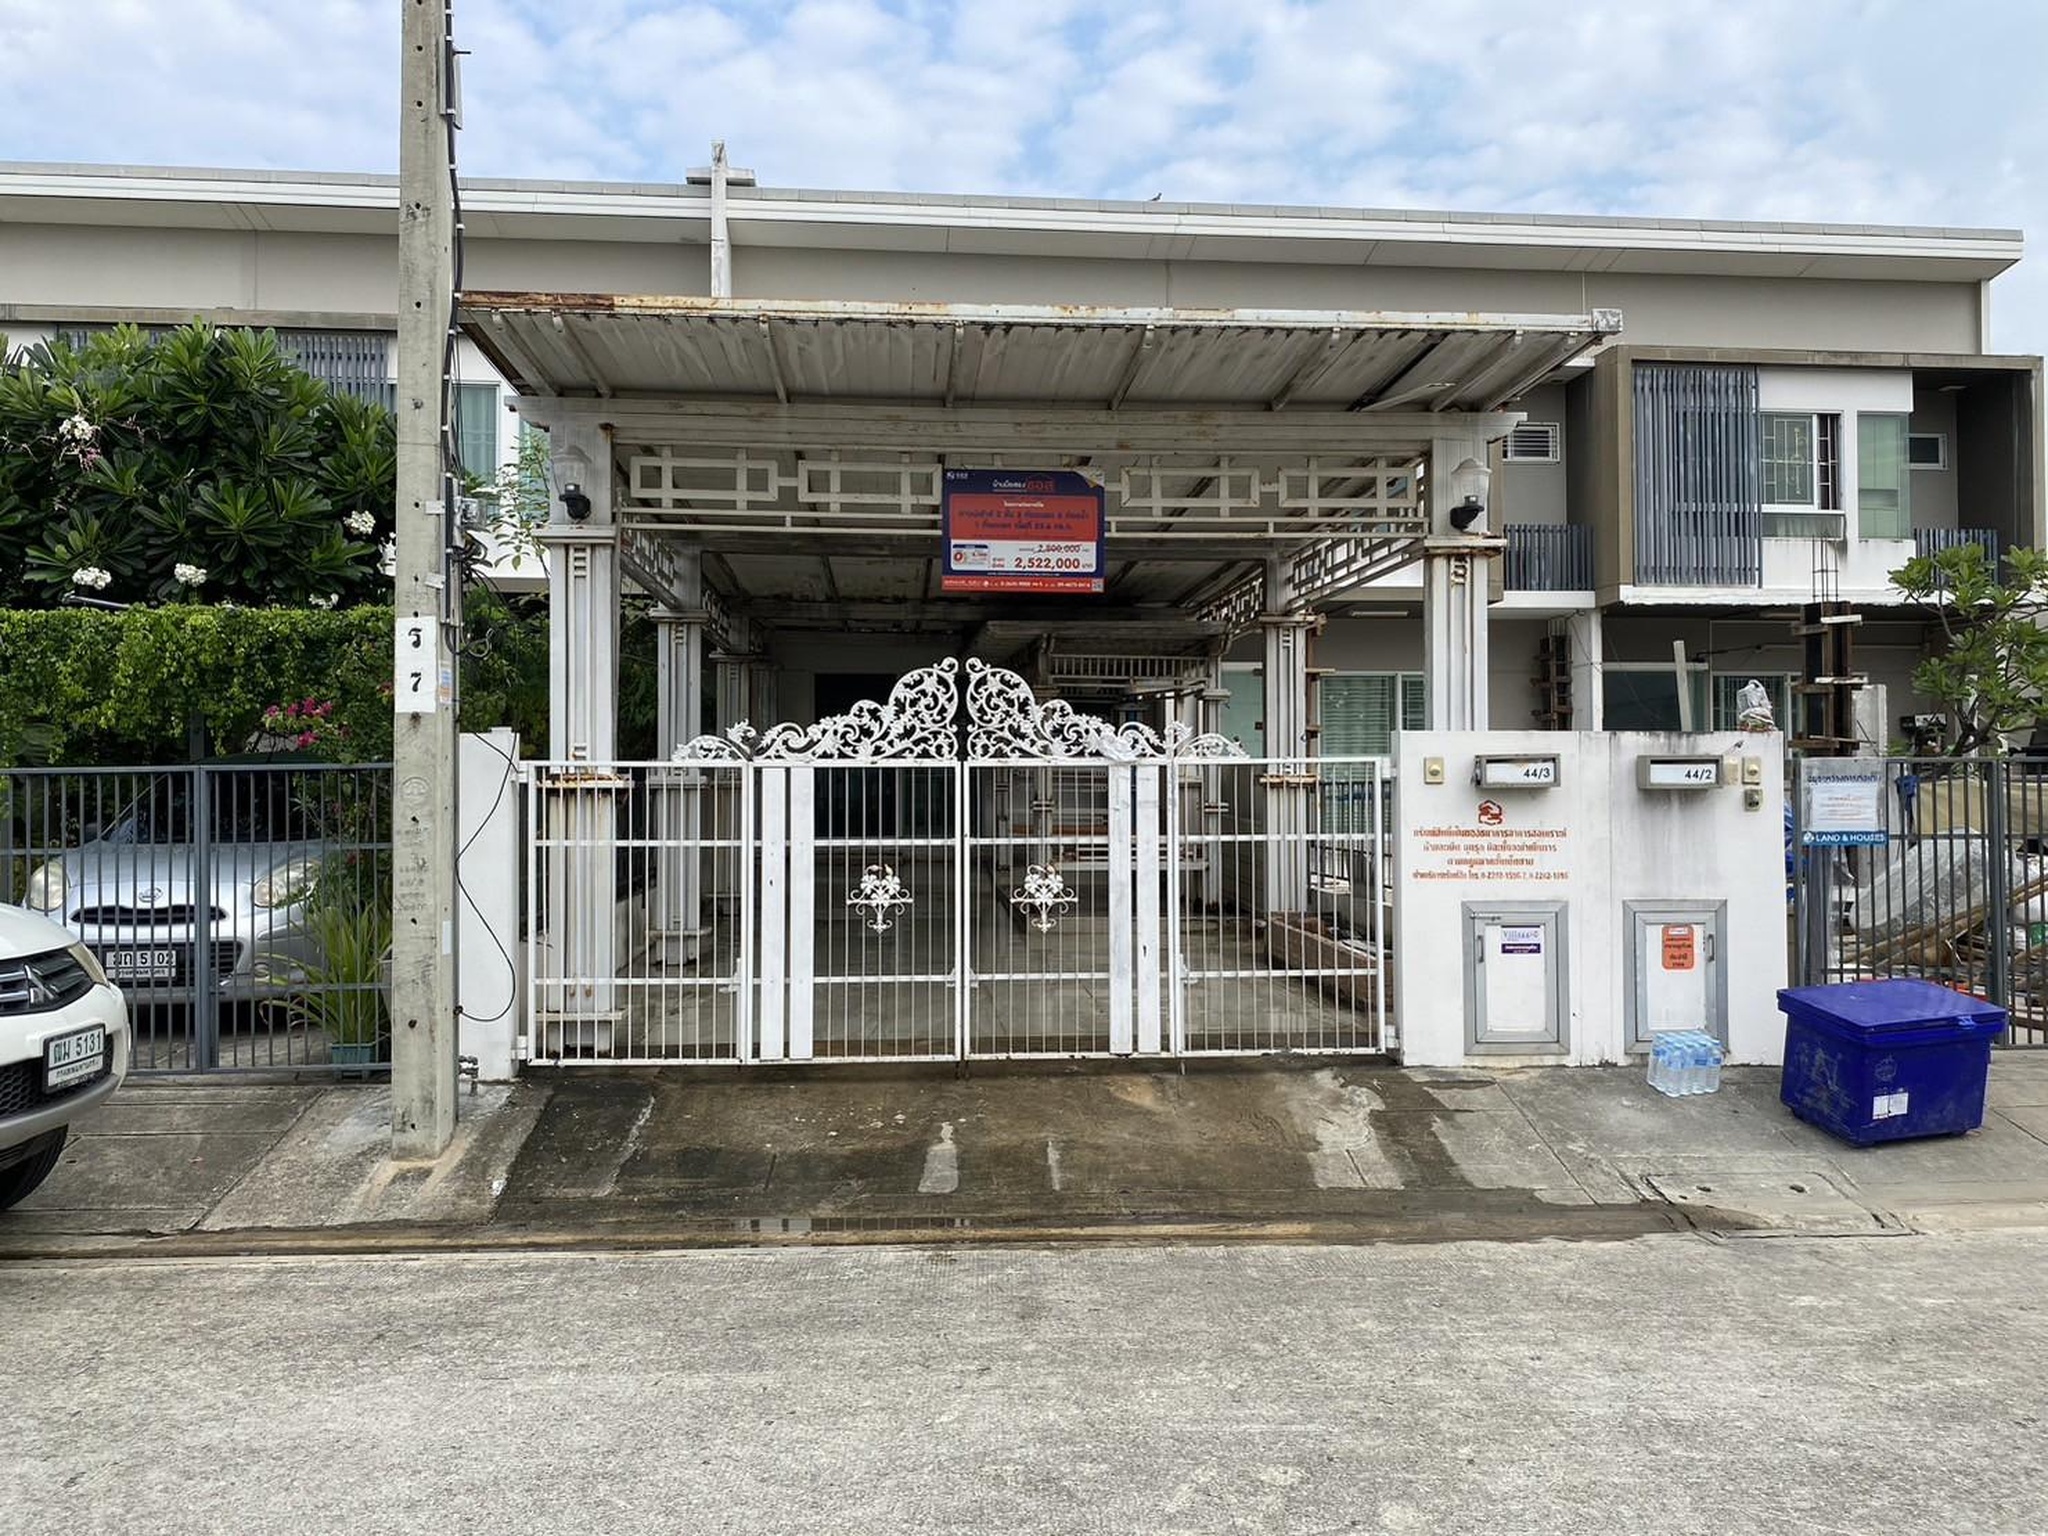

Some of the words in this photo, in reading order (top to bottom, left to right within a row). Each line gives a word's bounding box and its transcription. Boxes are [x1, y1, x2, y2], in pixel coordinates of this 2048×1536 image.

[1014, 557, 1080, 569] 2,522,000
[411, 672, 421, 692] 7
[1523, 767, 1550, 779] 44/3
[1685, 769, 1712, 780] 44/2
[140, 953, 173, 965] 502
[76, 1031, 101, 1056] 5131
